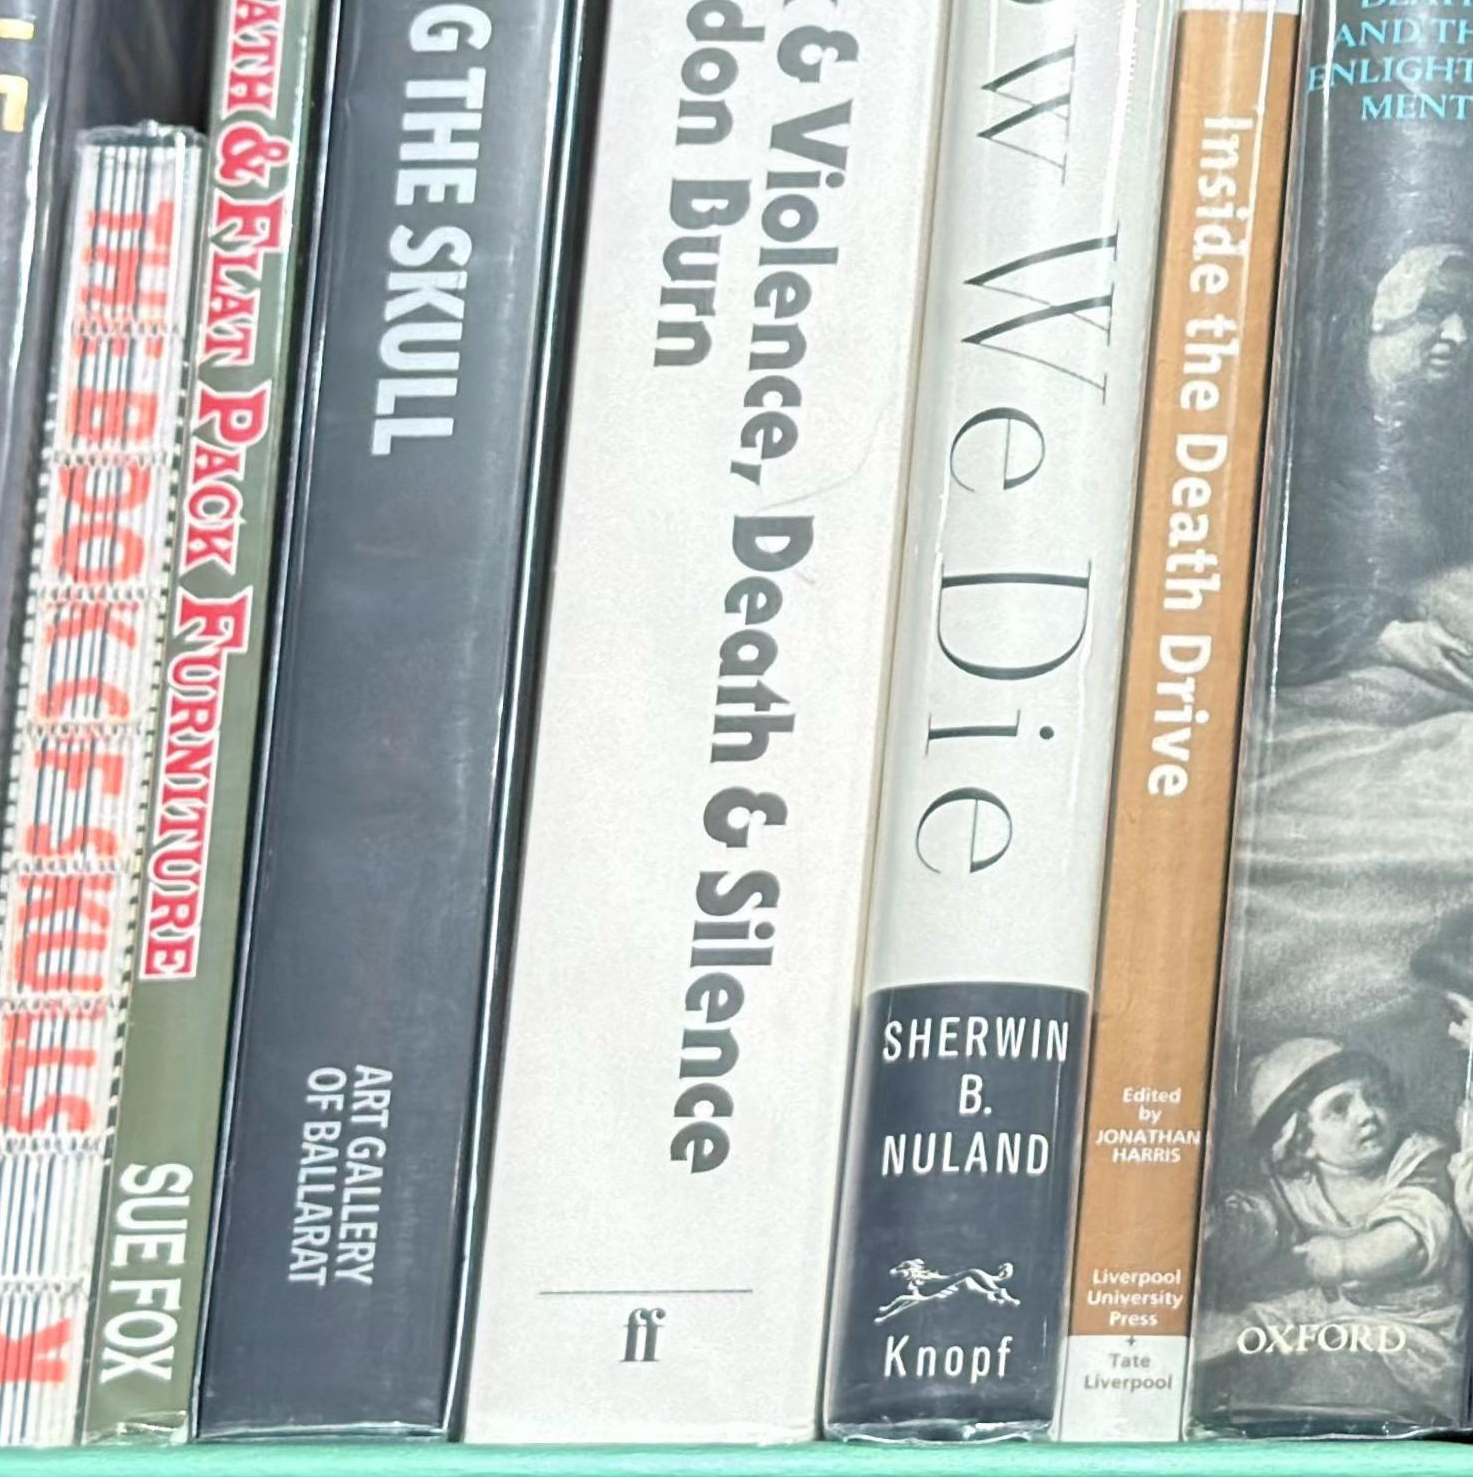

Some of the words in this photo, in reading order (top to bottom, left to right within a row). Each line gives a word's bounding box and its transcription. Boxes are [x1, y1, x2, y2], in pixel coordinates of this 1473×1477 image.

[776, 24, 861, 84] &
[1335, 18, 1422, 48] AND
[214, 124, 295, 188] &
[393, 64, 487, 207] THE
[1188, 115, 1254, 295] Inside
[72, 200, 174, 360] THE
[653, 177, 753, 368] Burn
[730, 98, 854, 486] Violence,
[370, 223, 474, 459] SKULL
[949, 219, 1119, 493] We
[1180, 312, 1240, 413] the
[44, 389, 159, 650] BOOK
[1162, 432, 1229, 611] Death
[710, 515, 815, 764] Death
[34, 677, 130, 797] OF
[915, 559, 1092, 874] Die
[1146, 634, 1213, 798] Drive
[703, 785, 789, 849] &
[670, 870, 781, 1174] Silence
[882, 1017, 1070, 1063] SHERWIN
[306, 1067, 347, 1112] OF
[350, 1064, 394, 1129] ART
[958, 1074, 993, 1115] B.
[1122, 1086, 1182, 1103] Edited
[1138, 1105, 1162, 1125] by
[881, 1131, 1051, 1176] NULAND
[1095, 1128, 1202, 1145] JONATHAN
[1112, 1147, 1181, 1163] HARRIS
[109, 1162, 194, 1268] SUE
[287, 1121, 342, 1288] BALLARAT
[333, 1136, 387, 1285] GALLERY
[1087, 1289, 1184, 1309] University
[1092, 1269, 1181, 1288] Liverpool
[99, 1277, 183, 1385] FOX
[620, 1308, 666, 1363] ff
[1108, 1310, 1158, 1326] Press
[1236, 1323, 1407, 1355] OXFORD
[884, 1335, 1014, 1384] Knopf
[1083, 1374, 1173, 1391] Liverpool
[1108, 1353, 1151, 1368] Tate
